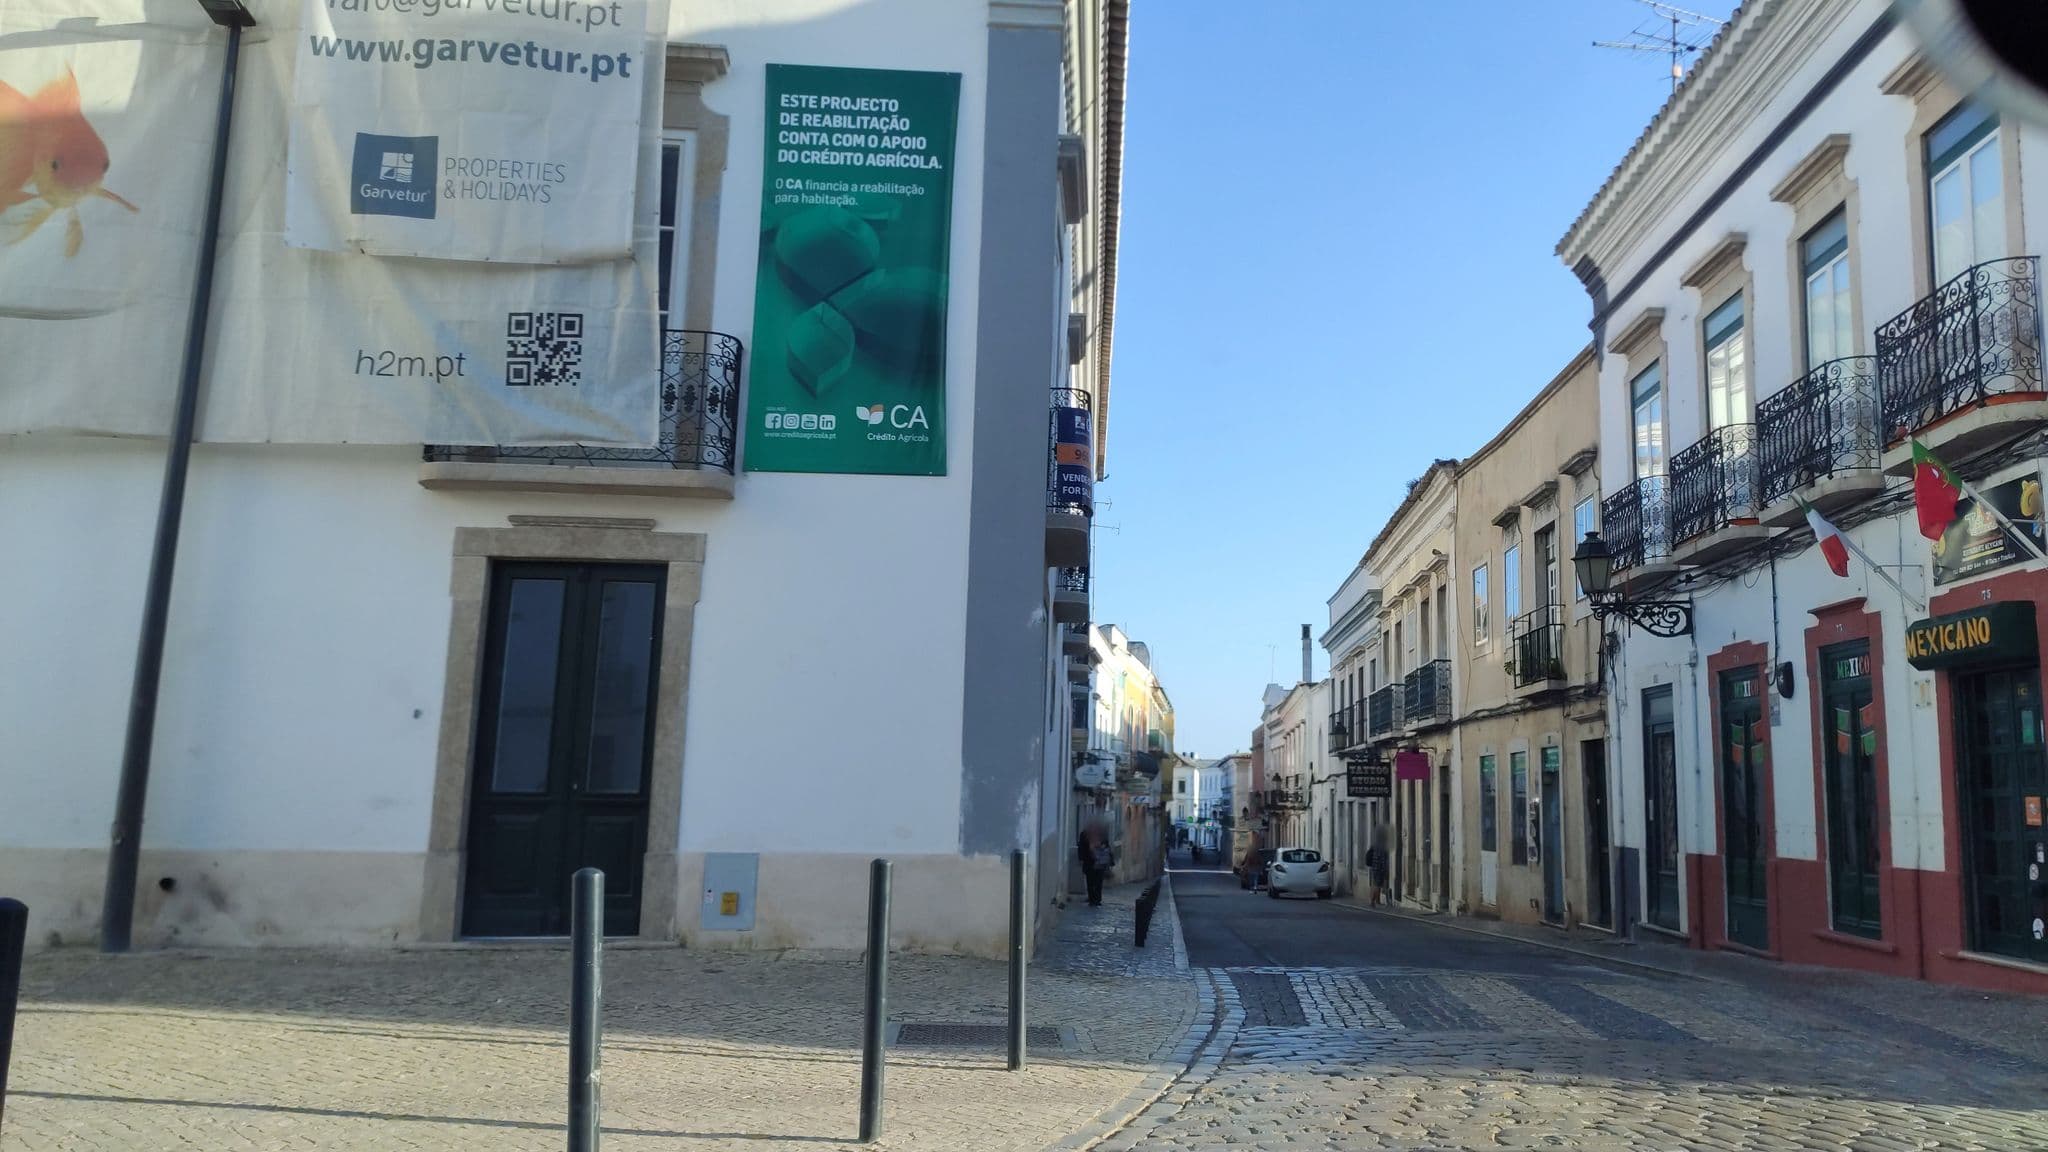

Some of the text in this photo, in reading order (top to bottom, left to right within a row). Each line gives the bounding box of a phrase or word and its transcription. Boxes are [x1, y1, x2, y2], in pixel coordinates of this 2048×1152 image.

[309, 34, 632, 83] www.garvetur.pt
[780, 94, 900, 112] ESTE PROJECTO
[779, 112, 910, 133] DE REABILITAÇÃO
[778, 131, 927, 150] CONTA COM O APOIO
[777, 148, 943, 170] DO CRÉDITO AGRÍCOLA.
[444, 157, 567, 184] PROPERTIES
[359, 183, 428, 203] Garvetur
[443, 179, 552, 204] & HOLIDAYS
[775, 178, 925, 197] O CA financia a reabilitação
[775, 193, 859, 208] para habitação.
[354, 349, 467, 384] h2m.pt
[890, 404, 930, 430] CA
[867, 431, 897, 441] Crédito
[1062, 486, 1081, 495] FOR
[1905, 616, 1991, 659] MEXICANO
[1836, 655, 1871, 680] MEXICO
[1733, 679, 1760, 699] MEXICO
[1349, 765, 1389, 775] TATTOO
